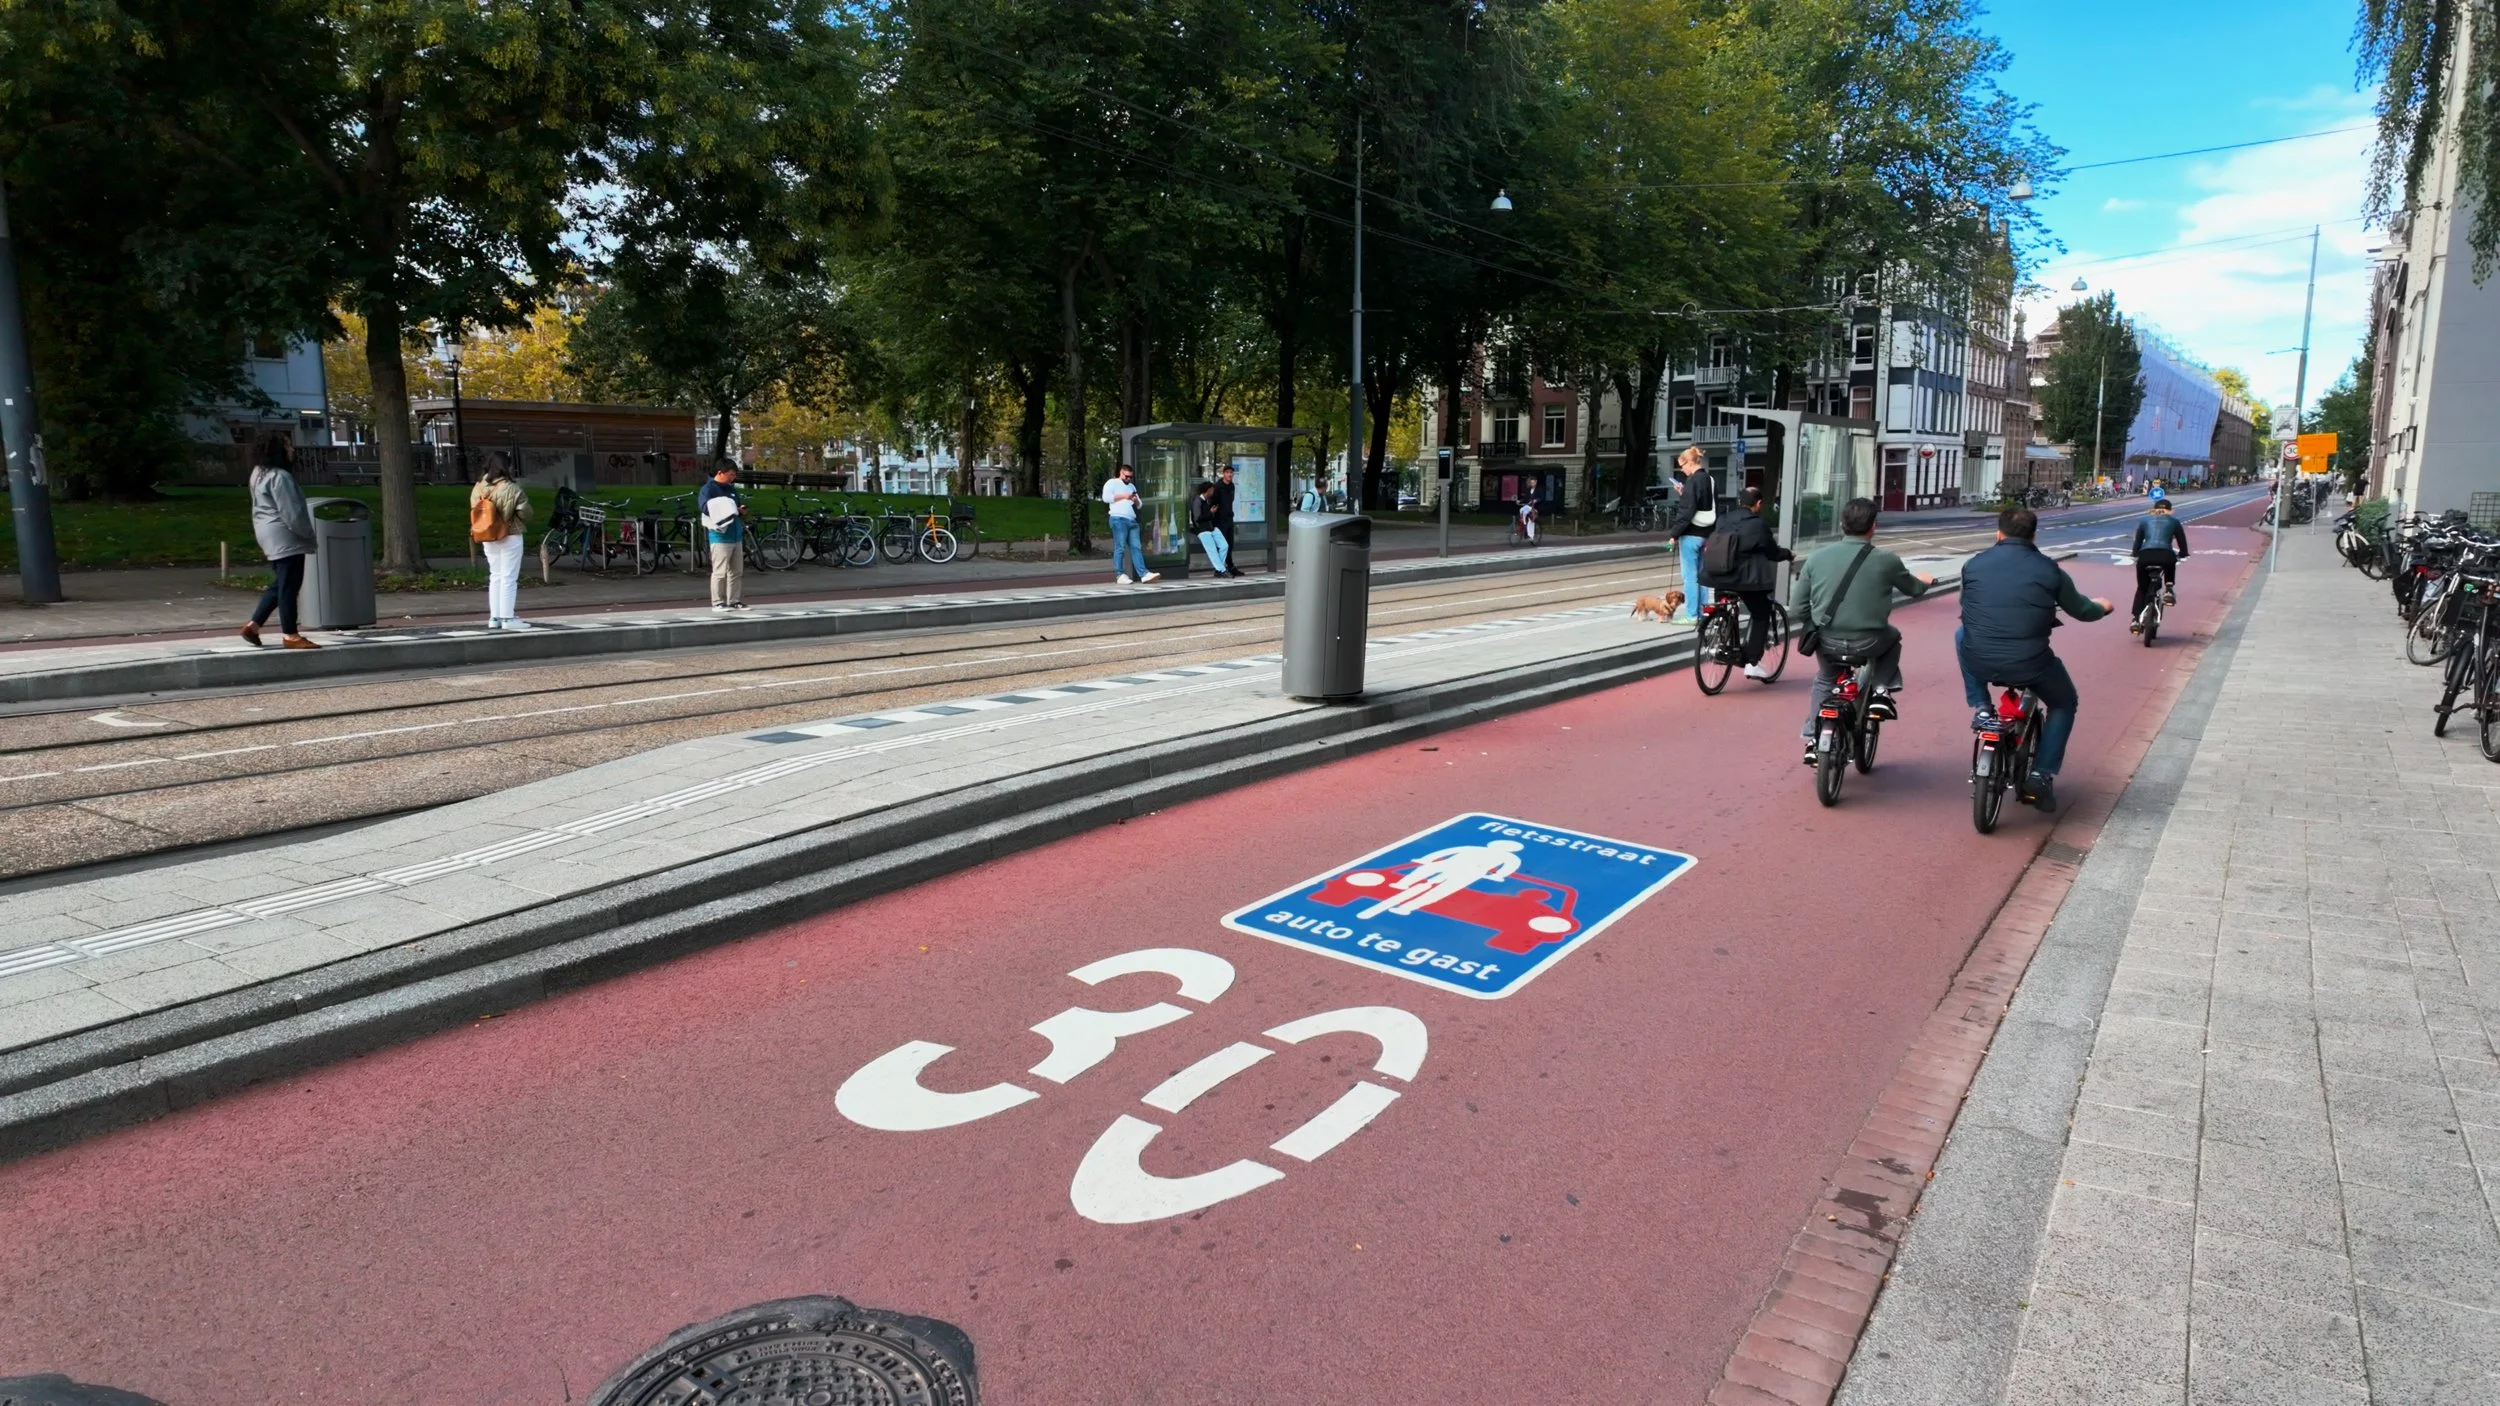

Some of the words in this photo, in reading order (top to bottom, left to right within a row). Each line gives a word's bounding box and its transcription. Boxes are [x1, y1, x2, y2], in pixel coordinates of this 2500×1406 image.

[1478, 821, 1657, 866] fietsstraat
[1265, 908, 1353, 940] auto
[1357, 928, 1402, 953] te
[1399, 942, 1501, 981] gast
[835, 948, 1428, 1224] 30
